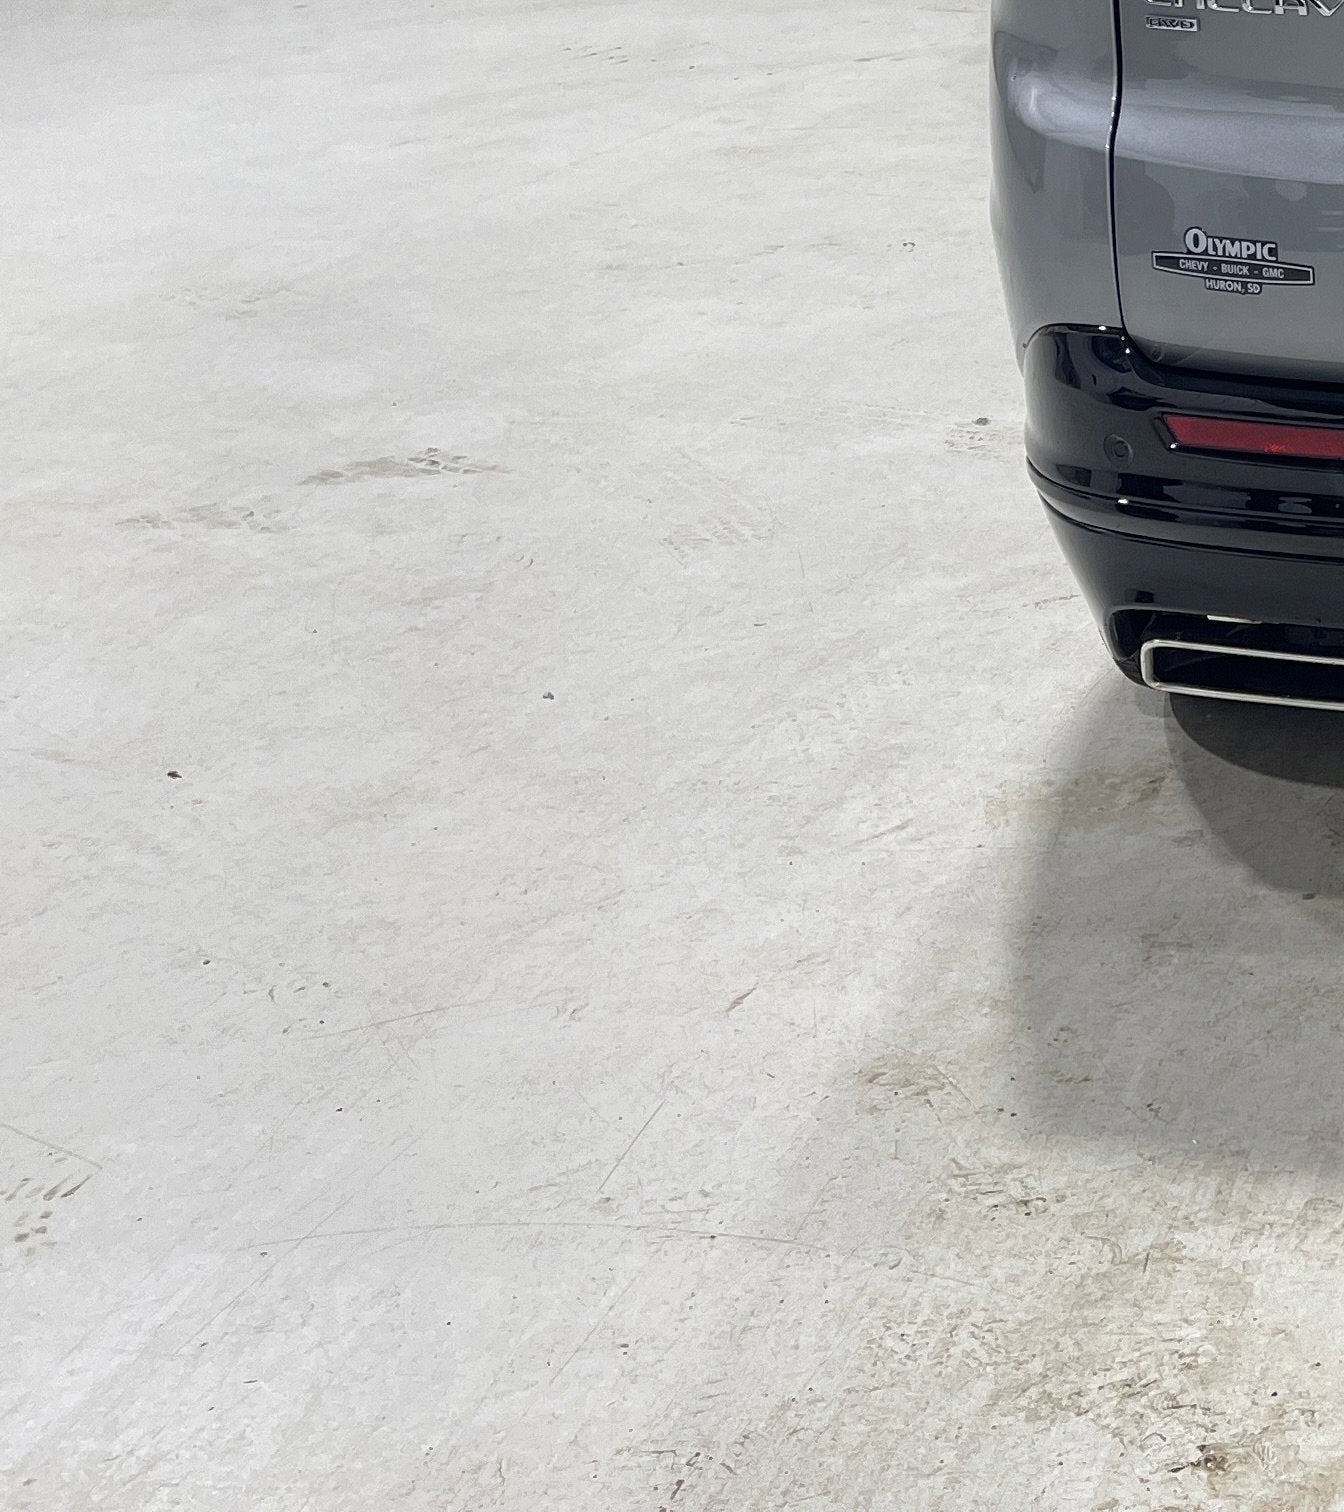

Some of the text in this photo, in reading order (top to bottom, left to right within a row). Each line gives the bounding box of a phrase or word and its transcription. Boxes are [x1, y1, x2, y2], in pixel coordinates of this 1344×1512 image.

[1184, 227, 1277, 261] OLYMPIC
[1179, 258, 1209, 272] CHEVY
[1221, 263, 1250, 276] BUICK
[1262, 267, 1285, 279] GMC
[1205, 278, 1261, 294] HURON, SD
